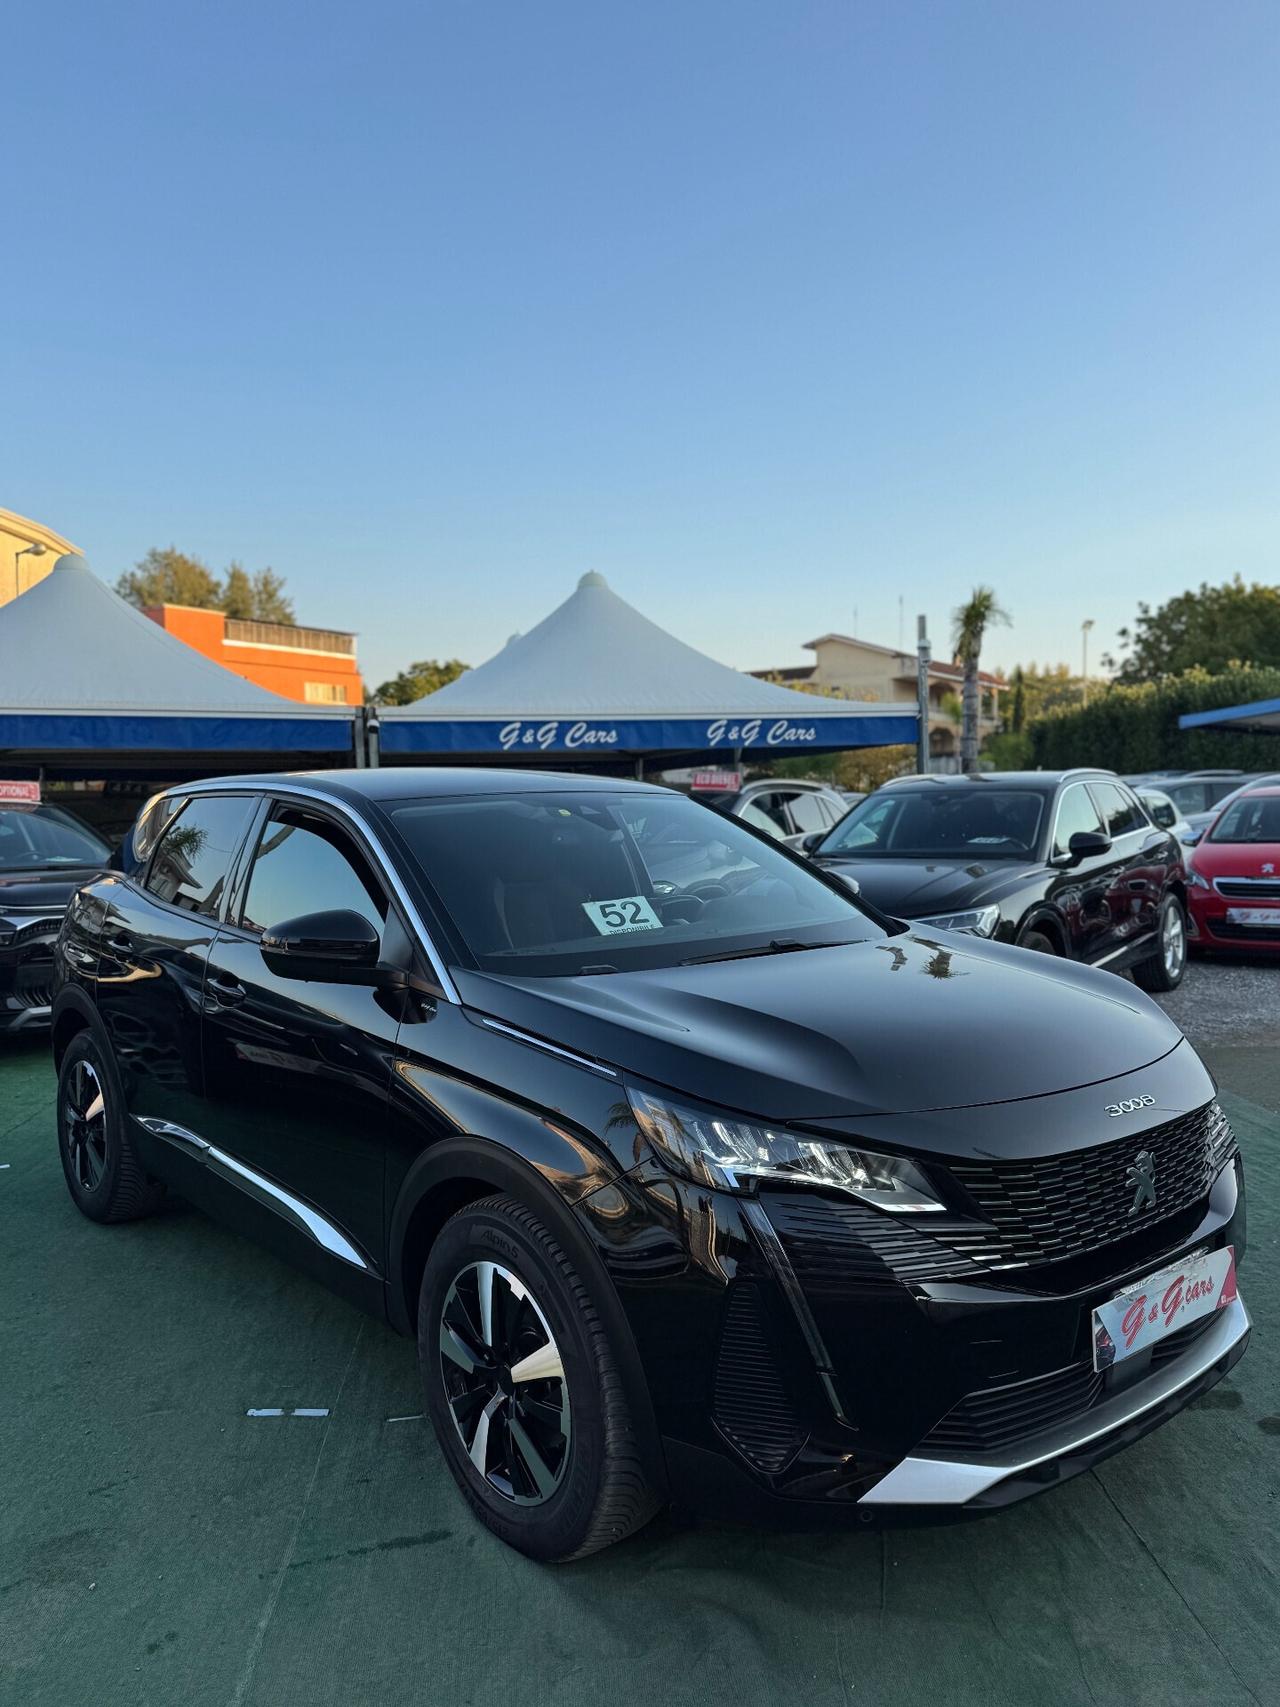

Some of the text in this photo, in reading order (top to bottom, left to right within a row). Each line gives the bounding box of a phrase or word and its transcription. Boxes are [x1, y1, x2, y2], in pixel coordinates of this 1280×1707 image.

[564, 722, 618, 748] Cars
[766, 719, 817, 746] Cars
[600, 900, 649, 927] 52
[1104, 1094, 1156, 1117] 3008
